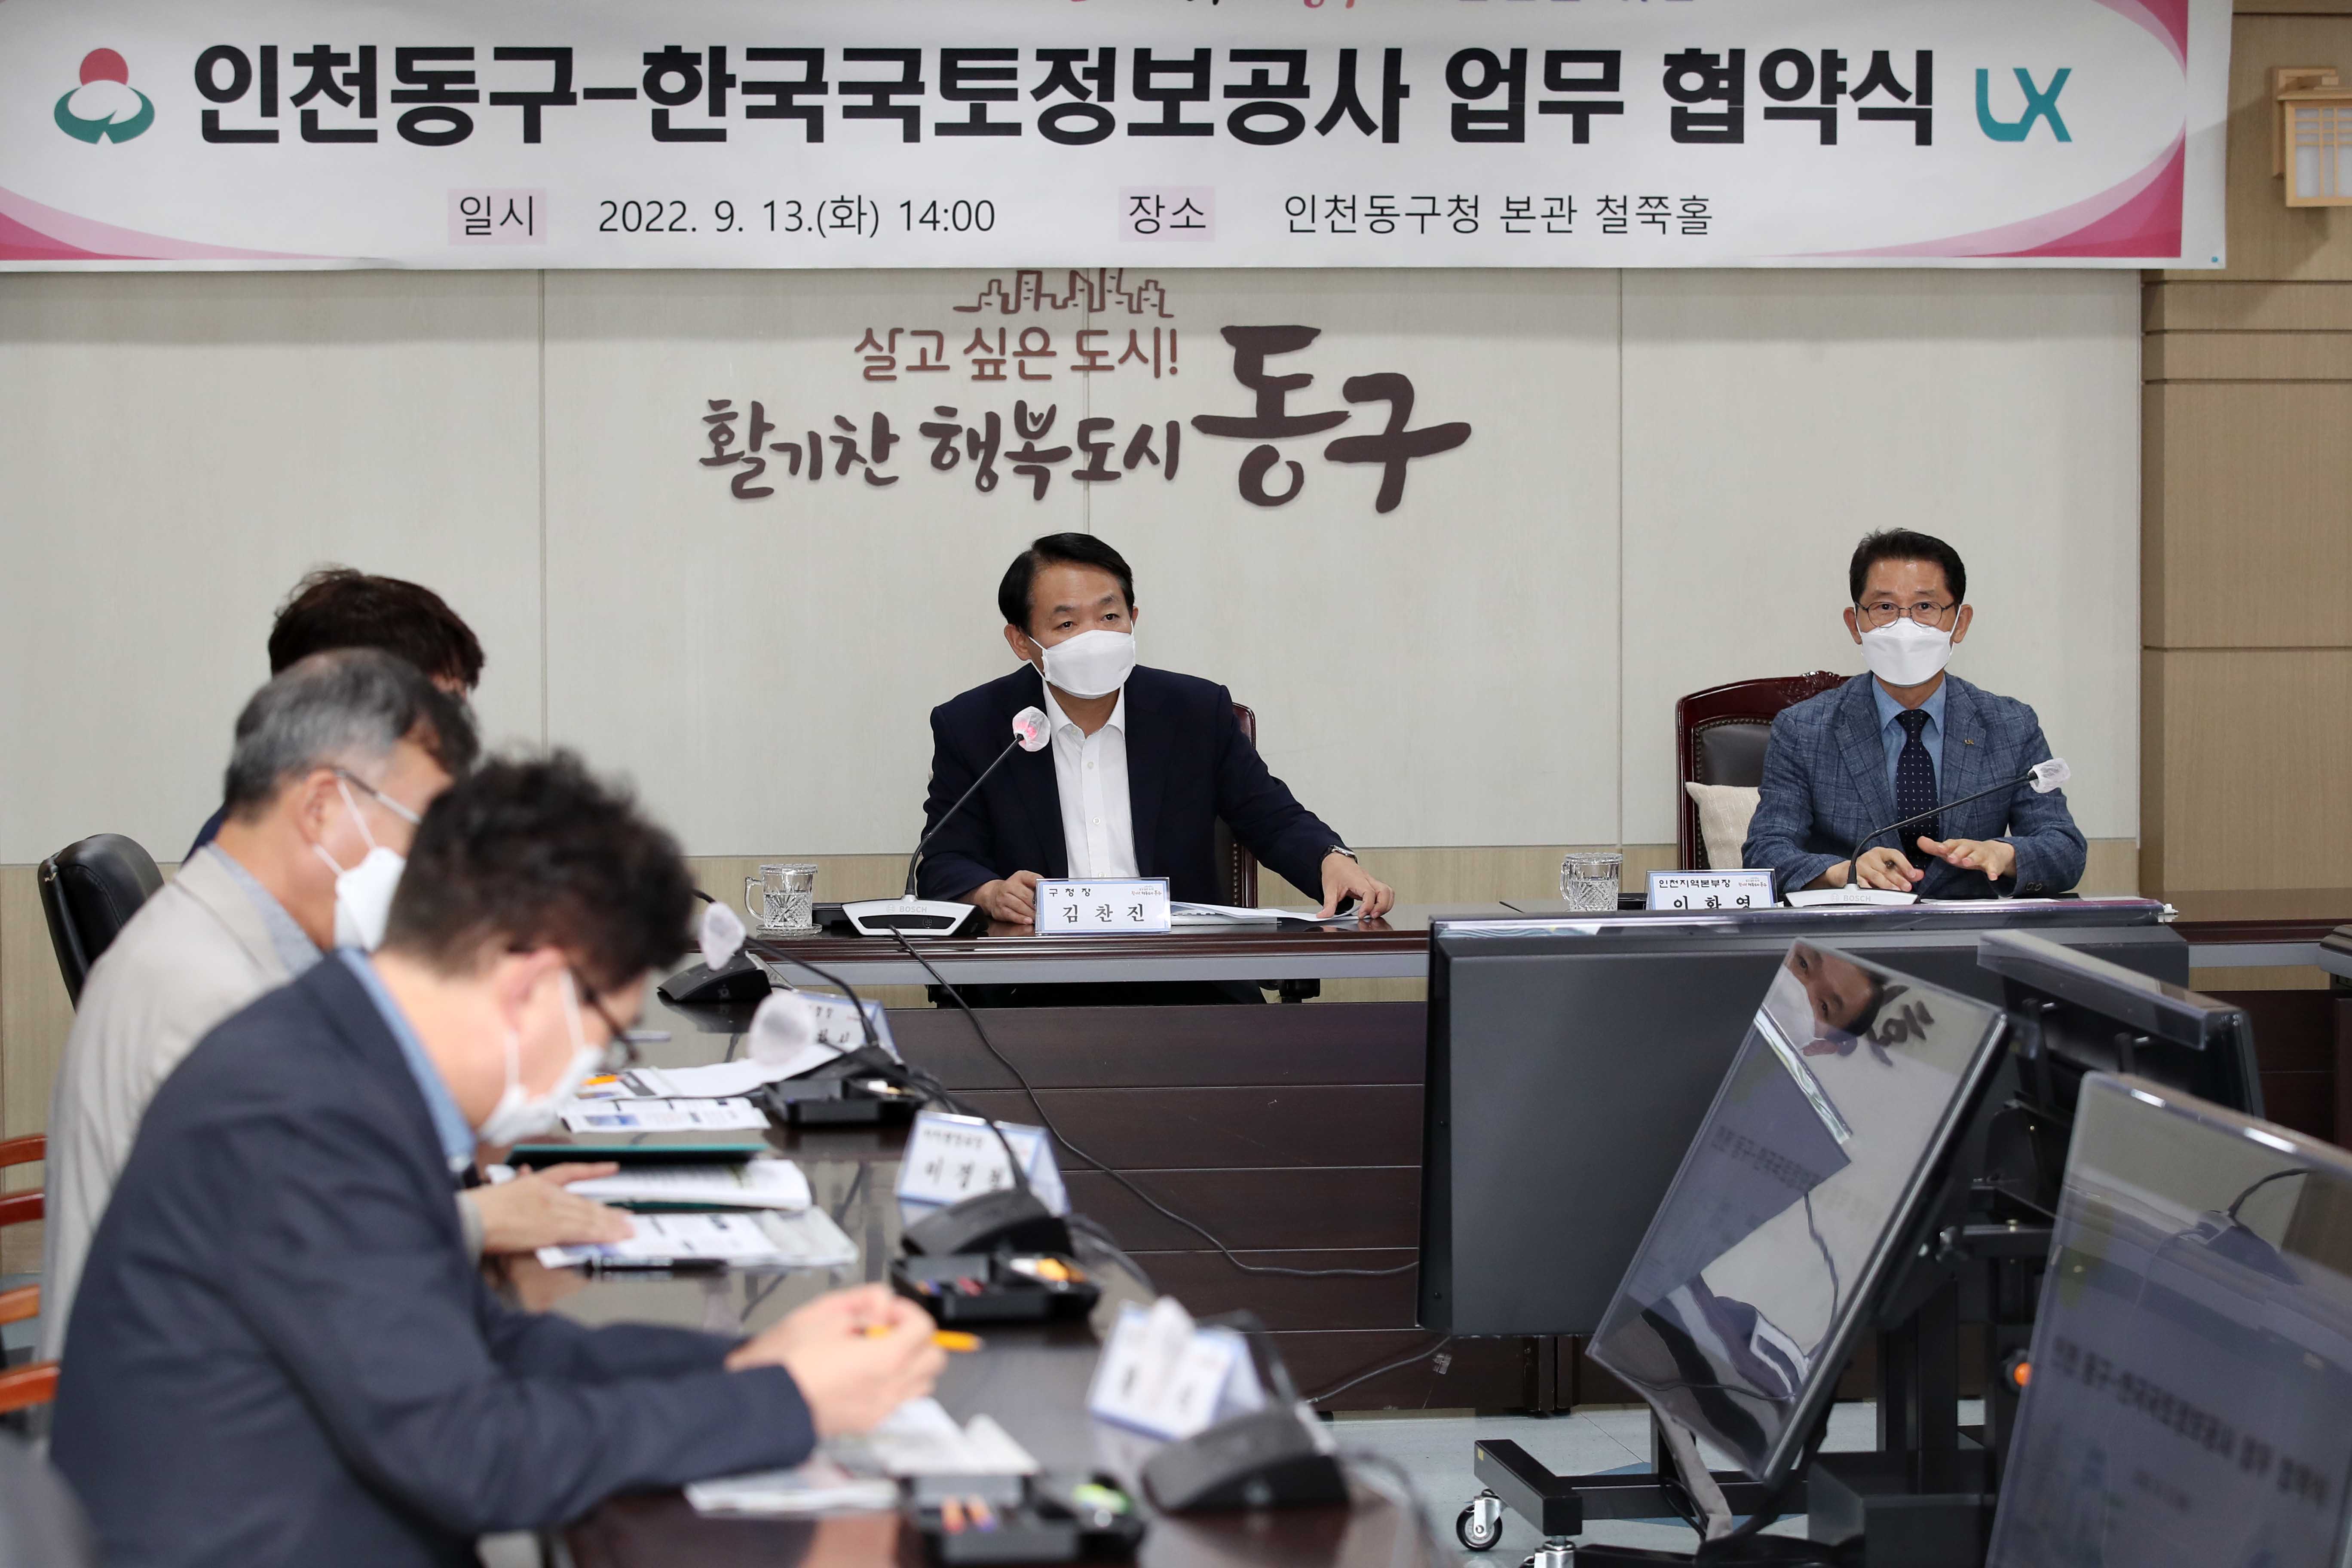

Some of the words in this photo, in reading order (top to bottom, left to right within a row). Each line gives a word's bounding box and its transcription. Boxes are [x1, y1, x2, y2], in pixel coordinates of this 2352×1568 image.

[195, 45, 1409, 146] 인천동구-한국국토정보공사
[1446, 48, 1623, 144] 업무
[1663, 49, 1932, 145] 협약식
[1976, 68, 2072, 142] LX
[461, 196, 533, 236] 일시
[599, 200, 696, 232] 2022.
[714, 200, 743, 232] 9.
[764, 195, 879, 238] 13.(화)
[900, 200, 995, 231] 14:00
[1130, 195, 1206, 234] 장소
[1285, 195, 1479, 234] 인천동구청
[1500, 195, 1577, 233] 본관
[1596, 195, 1712, 235] 철쭉홀
[854, 327, 951, 382] 살고
[963, 326, 1058, 381] 싶은
[1070, 322, 1178, 379] 도시!
[698, 399, 900, 499] 활기찬
[919, 400, 1181, 501] 행복도시
[1191, 325, 1472, 514] 동구
[1659, 879, 1730, 888] 인천지역본부장
